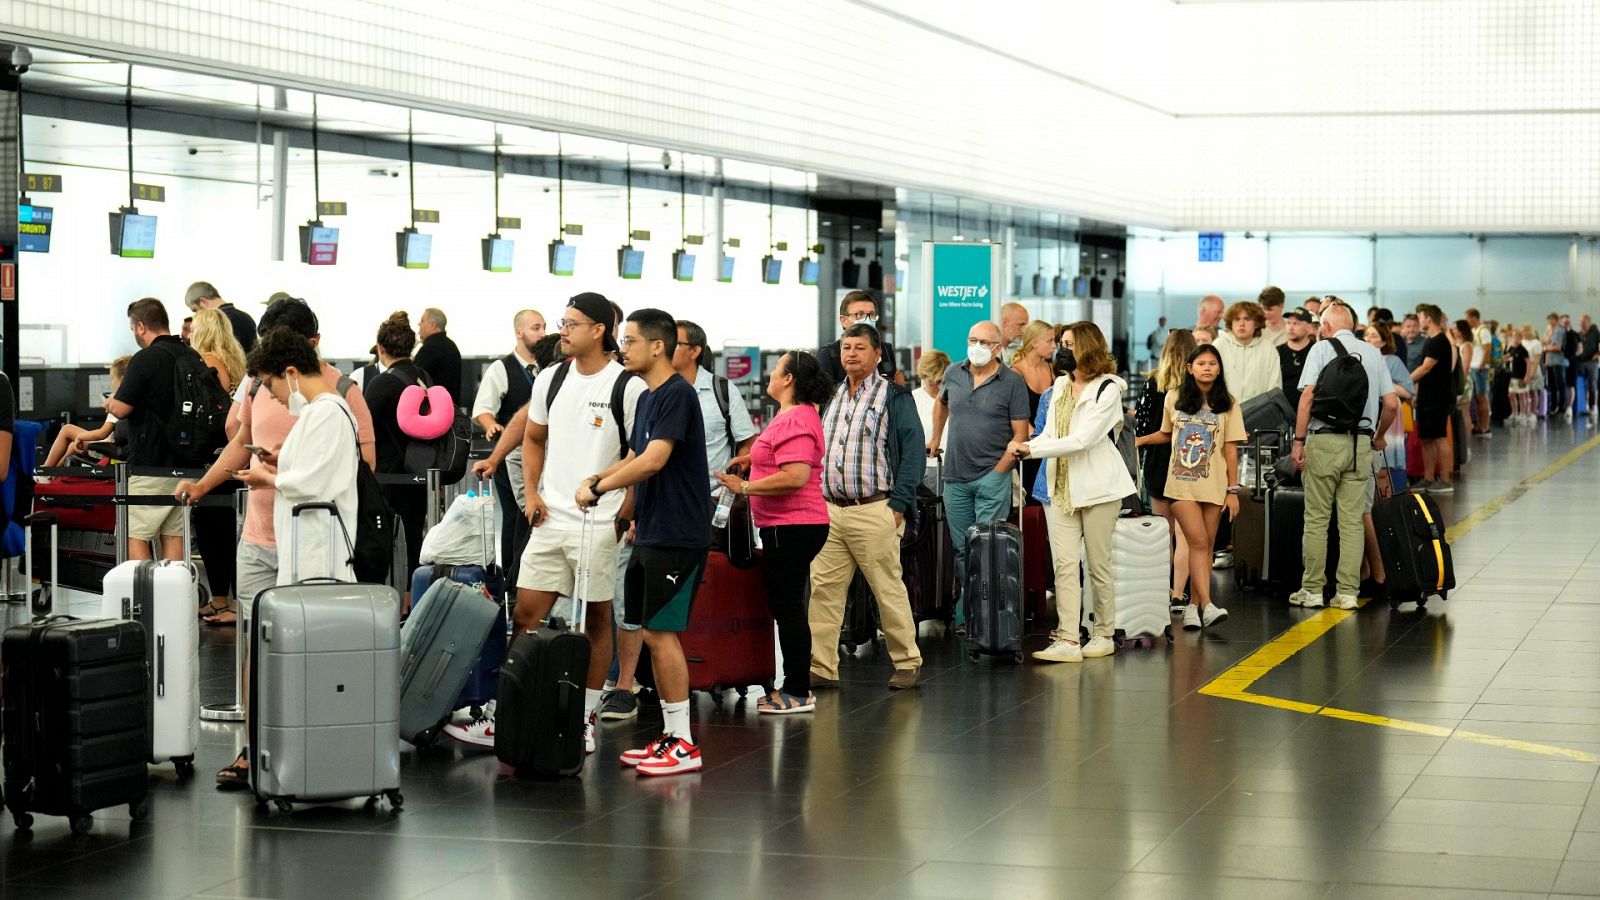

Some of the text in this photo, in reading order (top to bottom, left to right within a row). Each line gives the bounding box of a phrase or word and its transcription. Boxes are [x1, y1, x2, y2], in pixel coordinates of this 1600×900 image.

[42, 176, 52, 190] 87
[19, 223, 46, 234] TORONTO
[937, 285, 978, 301] WESTJET
